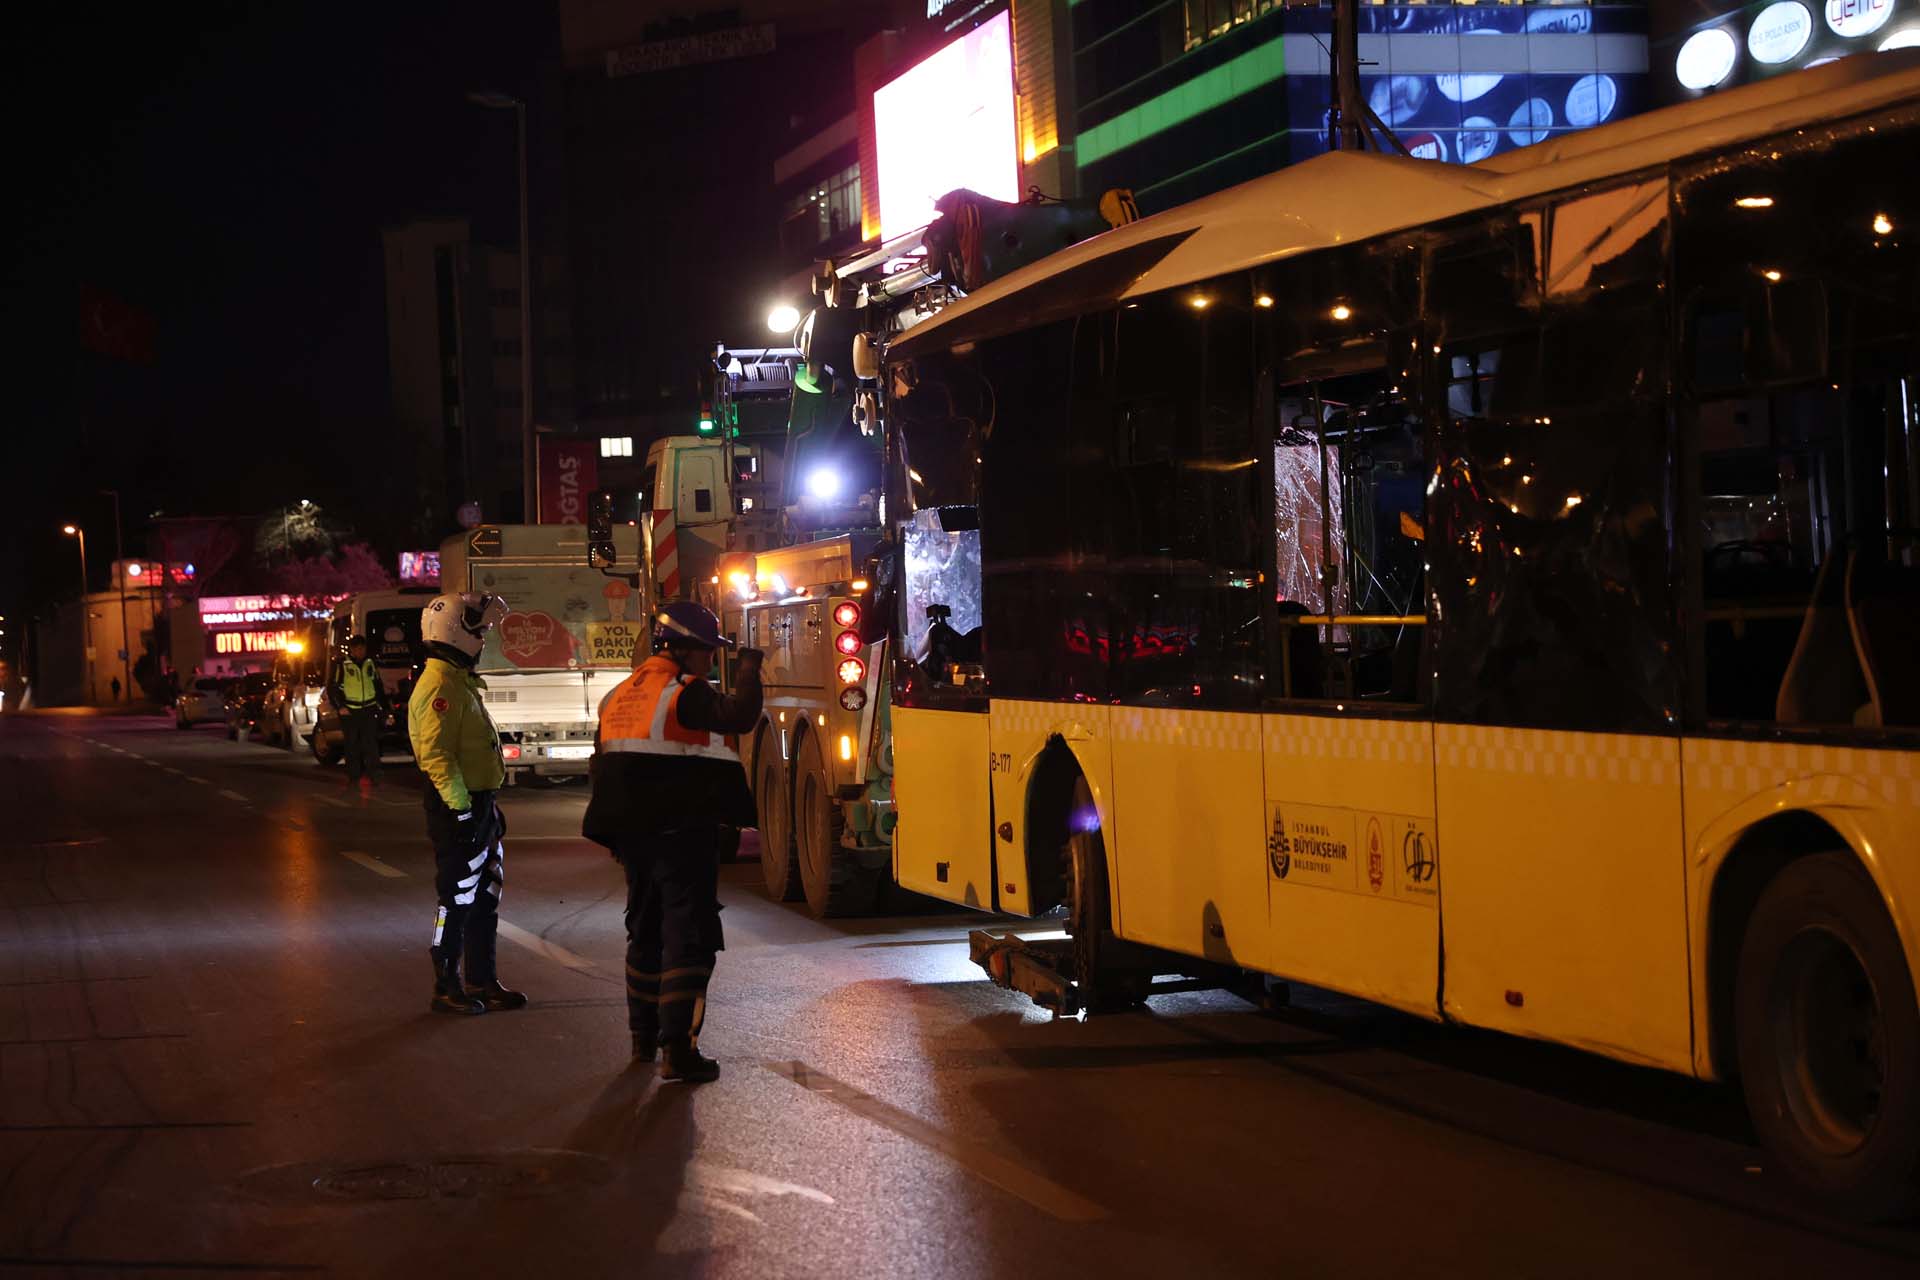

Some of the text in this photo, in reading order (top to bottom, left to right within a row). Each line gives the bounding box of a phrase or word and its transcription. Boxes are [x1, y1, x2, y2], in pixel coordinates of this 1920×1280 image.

[604, 626, 632, 636] YOL
[216, 633, 242, 654] OTO
[991, 752, 1011, 774] B-177
[1294, 836, 1347, 861] BÜYÜKŞEHİR
